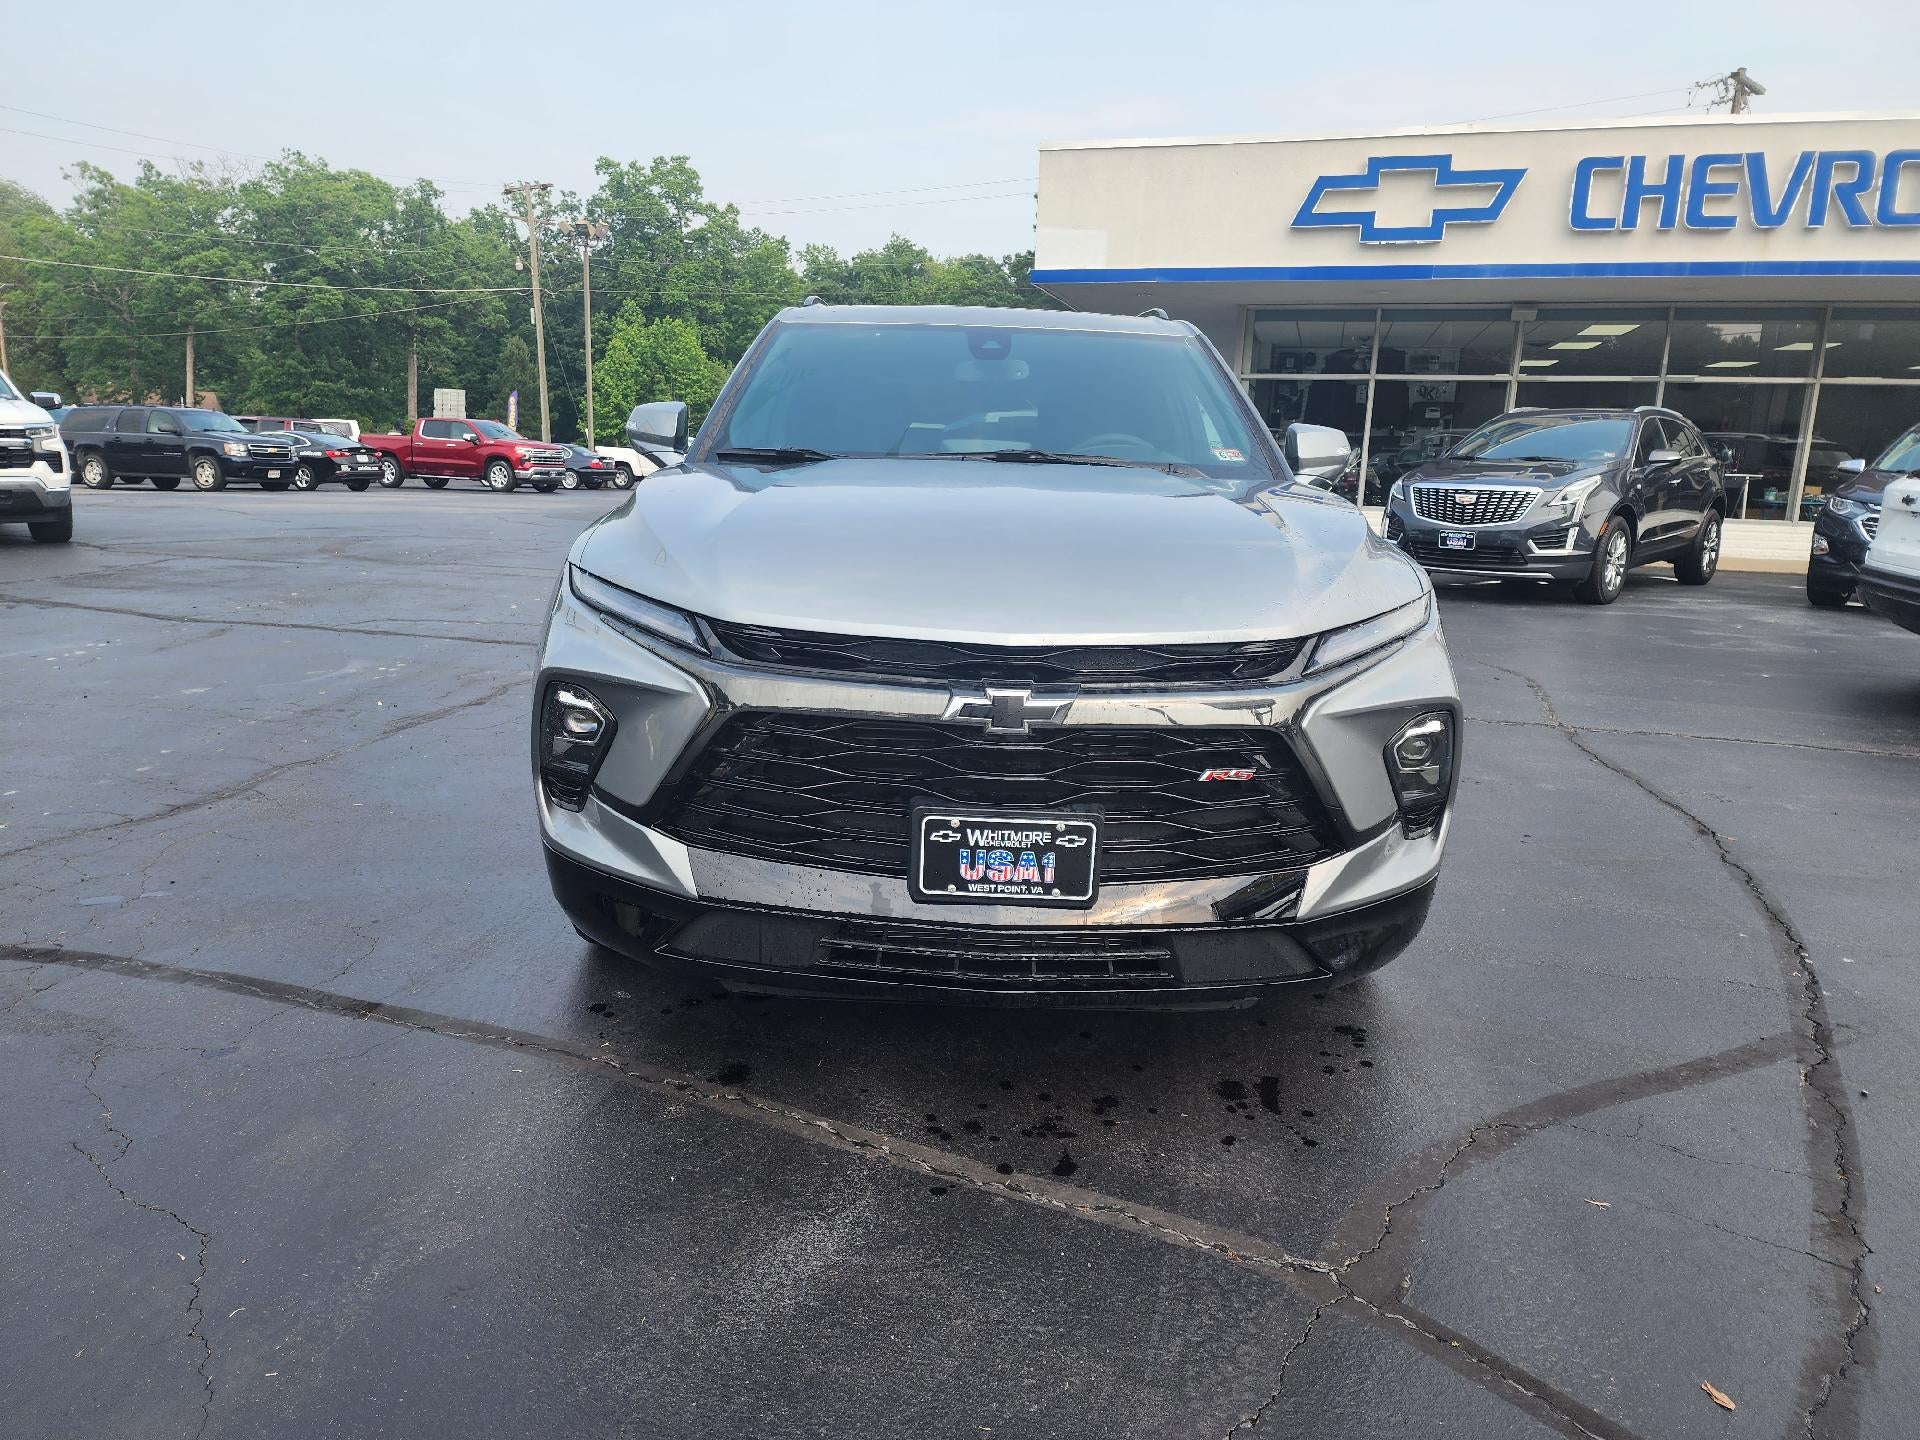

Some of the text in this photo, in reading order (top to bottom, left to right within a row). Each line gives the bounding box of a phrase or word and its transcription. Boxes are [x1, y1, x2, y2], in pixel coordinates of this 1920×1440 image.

[1570, 149, 1920, 231] CHEVRO
[1198, 769, 1255, 781] RS
[966, 829, 1052, 846] WHITMORE
[984, 839, 1033, 849] CHEVROLET
[959, 848, 1056, 883] USA1
[968, 883, 1044, 895] WEST POINT, VA
